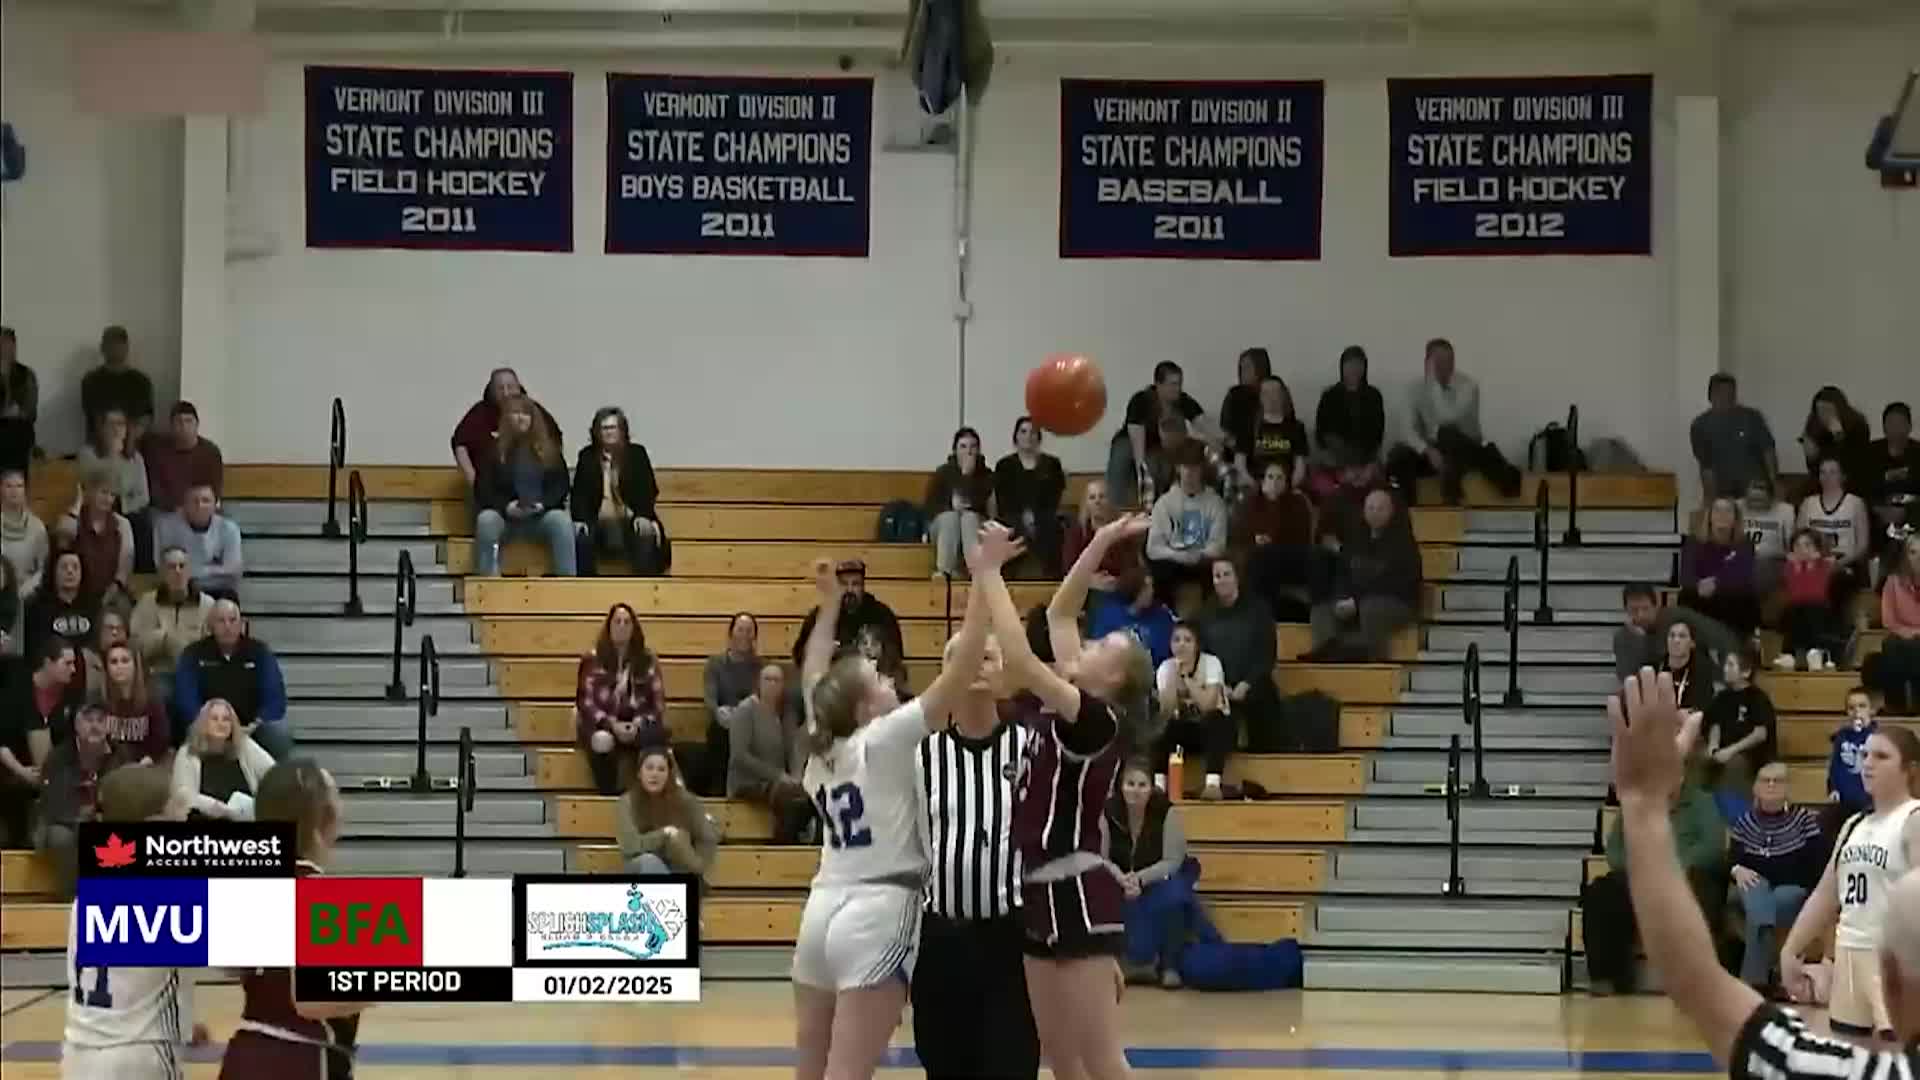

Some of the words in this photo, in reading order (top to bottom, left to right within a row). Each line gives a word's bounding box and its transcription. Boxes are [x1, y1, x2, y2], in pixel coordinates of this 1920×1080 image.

[334, 86, 424, 113] VERMONT
[434, 89, 513, 116] DIVISION
[522, 90, 544, 116] III
[643, 91, 730, 119] VERMONT
[738, 94, 814, 120] DIVISION
[822, 95, 836, 120] II
[1093, 97, 1181, 123] VERMONT
[1191, 98, 1268, 124] DIVISION
[1277, 98, 1292, 123] II
[1415, 96, 1504, 122] VERMONT
[1513, 95, 1592, 121] DIVISION
[1602, 95, 1624, 121] III
[326, 123, 404, 158] STATE
[414, 126, 553, 160] CHAMPIONS
[628, 129, 705, 163] STATE
[713, 131, 851, 164] CHAMPIONS
[1081, 134, 1156, 167] STATE
[1165, 135, 1302, 168] CHAMPIONS
[1407, 133, 1484, 167] STATE
[1492, 131, 1632, 167] CHAMPIONS
[331, 167, 418, 194] FIELD
[427, 169, 546, 197] HOCKEY
[621, 174, 684, 199] BOYS
[692, 175, 855, 202] BASKETBALL
[1097, 177, 1283, 204] BASEBALL
[1413, 177, 1500, 203] FIELD
[1507, 175, 1626, 202] HOCKEY
[401, 207, 477, 232] 2011
[700, 212, 775, 238] 2011
[1154, 215, 1225, 240] 2011
[1475, 212, 1565, 238] 2012
[813, 781, 873, 849] 12
[1845, 872, 1868, 905] 20
